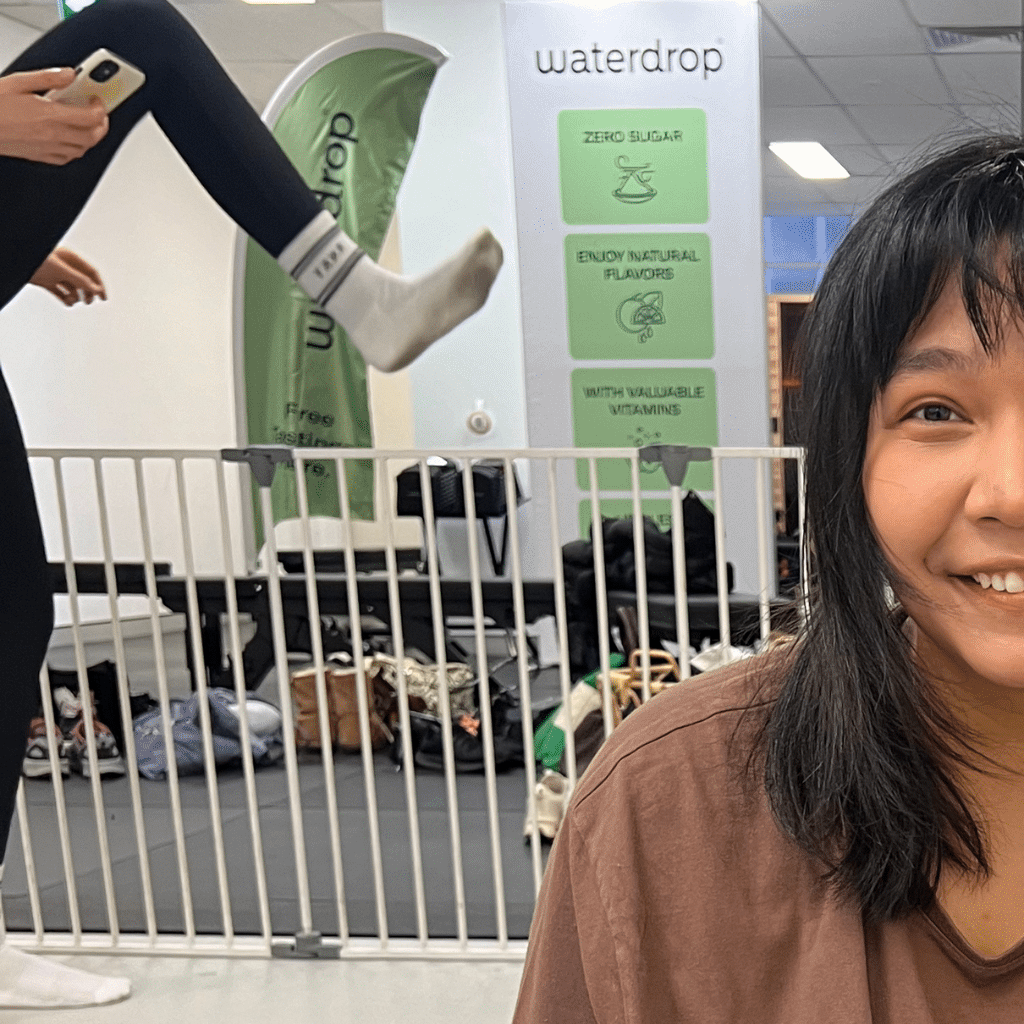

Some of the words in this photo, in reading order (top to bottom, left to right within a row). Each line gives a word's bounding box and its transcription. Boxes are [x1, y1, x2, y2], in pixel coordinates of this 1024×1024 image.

[535, 38, 723, 80] waterdrop
[582, 130, 625, 143] ZERO
[627, 130, 683, 143] SUGAR
[306, 112, 358, 351] wdrop
[576, 249, 625, 263] ENJOY
[627, 249, 701, 263] NATURAL
[603, 267, 675, 281] FLAVORS
[583, 385, 624, 399] WITH
[627, 385, 706, 399] VALUABLE
[608, 403, 682, 416] VITAMINS
